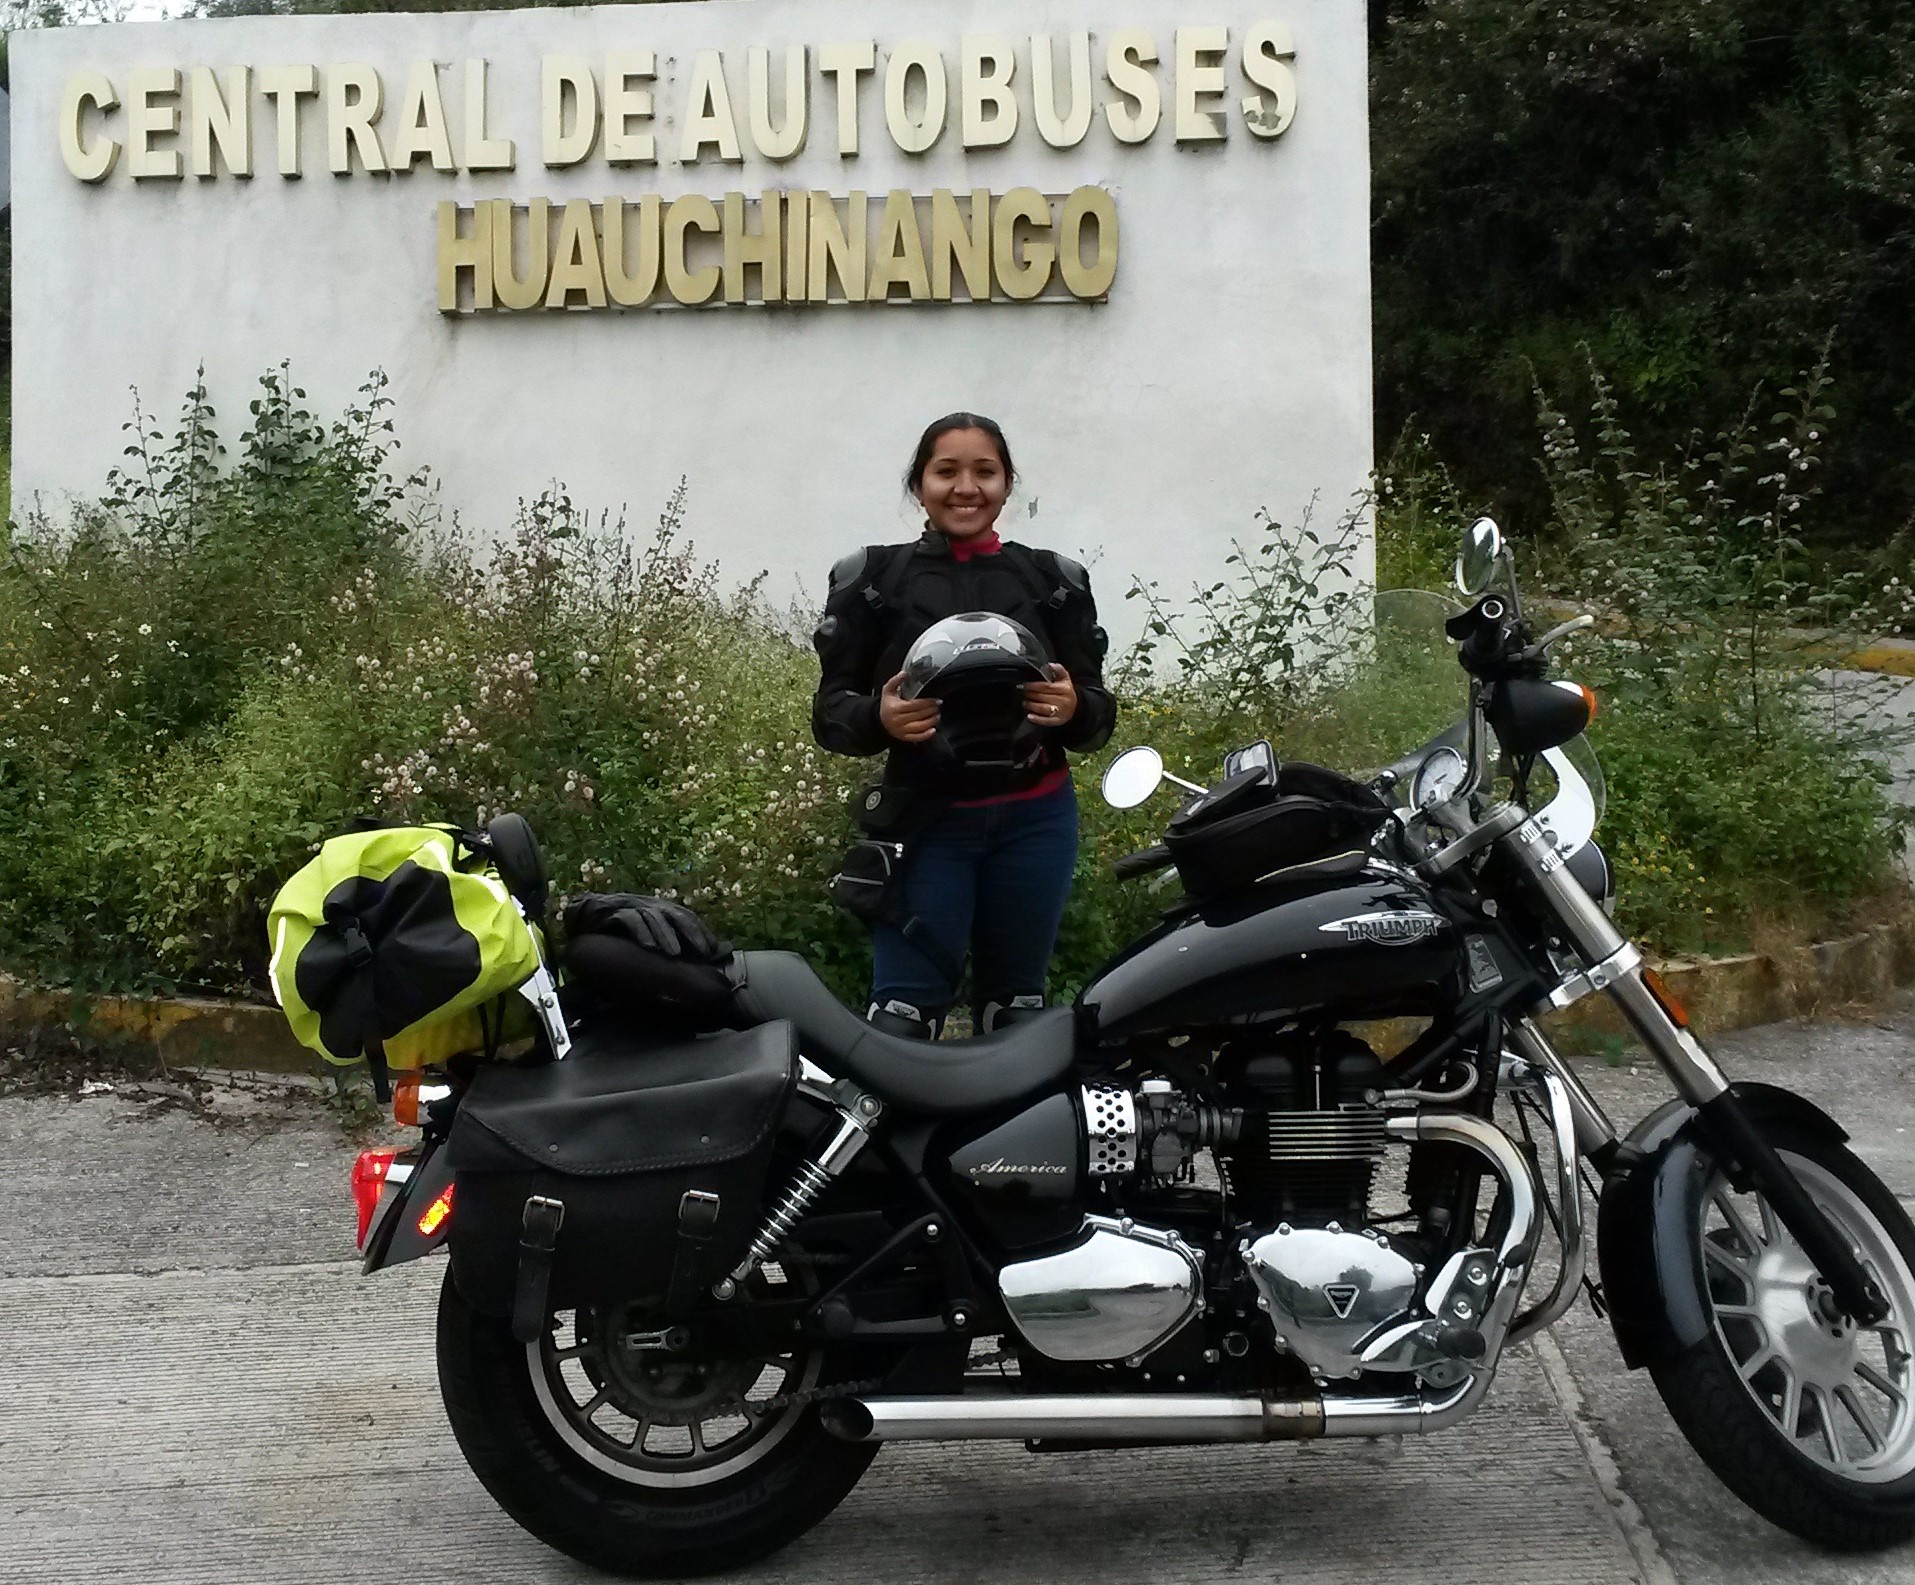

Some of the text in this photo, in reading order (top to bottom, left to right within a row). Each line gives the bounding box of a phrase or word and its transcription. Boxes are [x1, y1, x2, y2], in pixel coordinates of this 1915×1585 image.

[59, 21, 1299, 183] CENTRAL DE AUTOBUSES
[437, 185, 1120, 312] HUAUCHINANGO
[1342, 918, 1438, 942] TRIUMPH
[969, 1157, 1067, 1175] America
